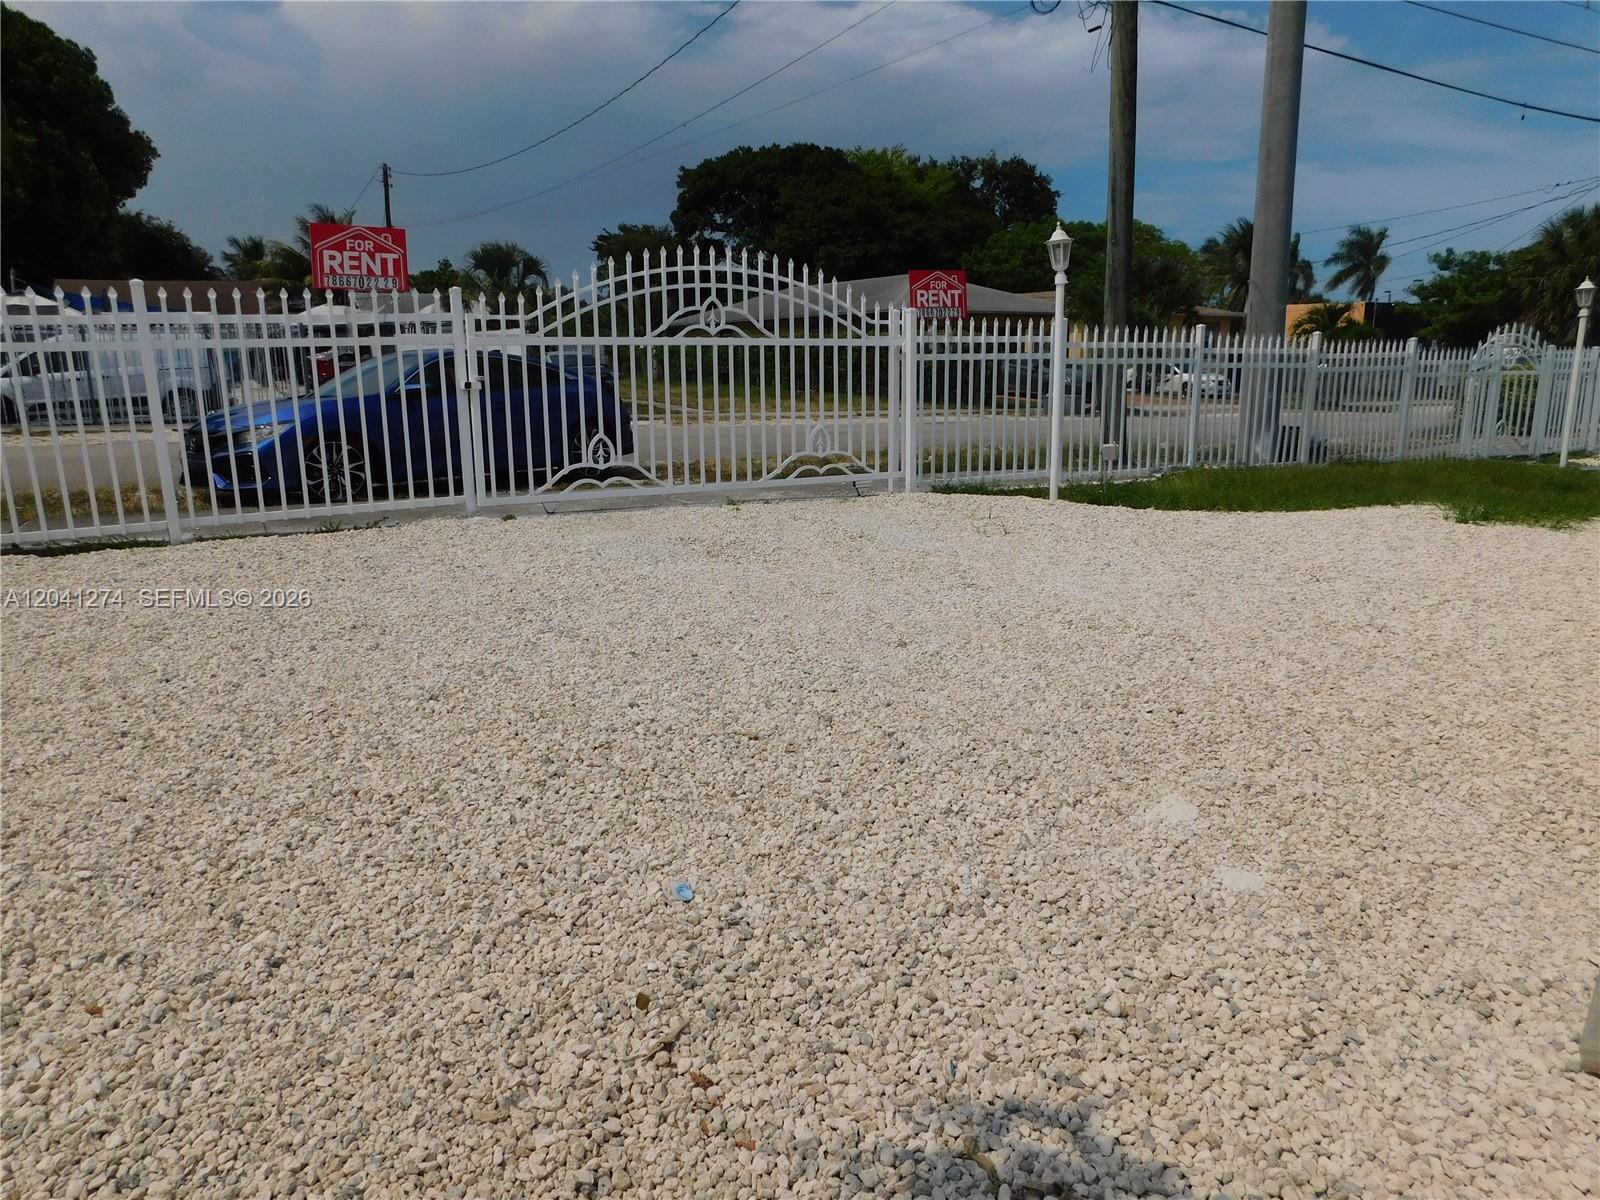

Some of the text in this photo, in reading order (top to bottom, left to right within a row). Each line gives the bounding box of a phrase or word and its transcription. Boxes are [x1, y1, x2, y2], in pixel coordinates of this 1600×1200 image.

[346, 239, 374, 252] FOR
[323, 250, 399, 276] RENT
[930, 281, 947, 289] FOR
[917, 290, 961, 307] RENT
